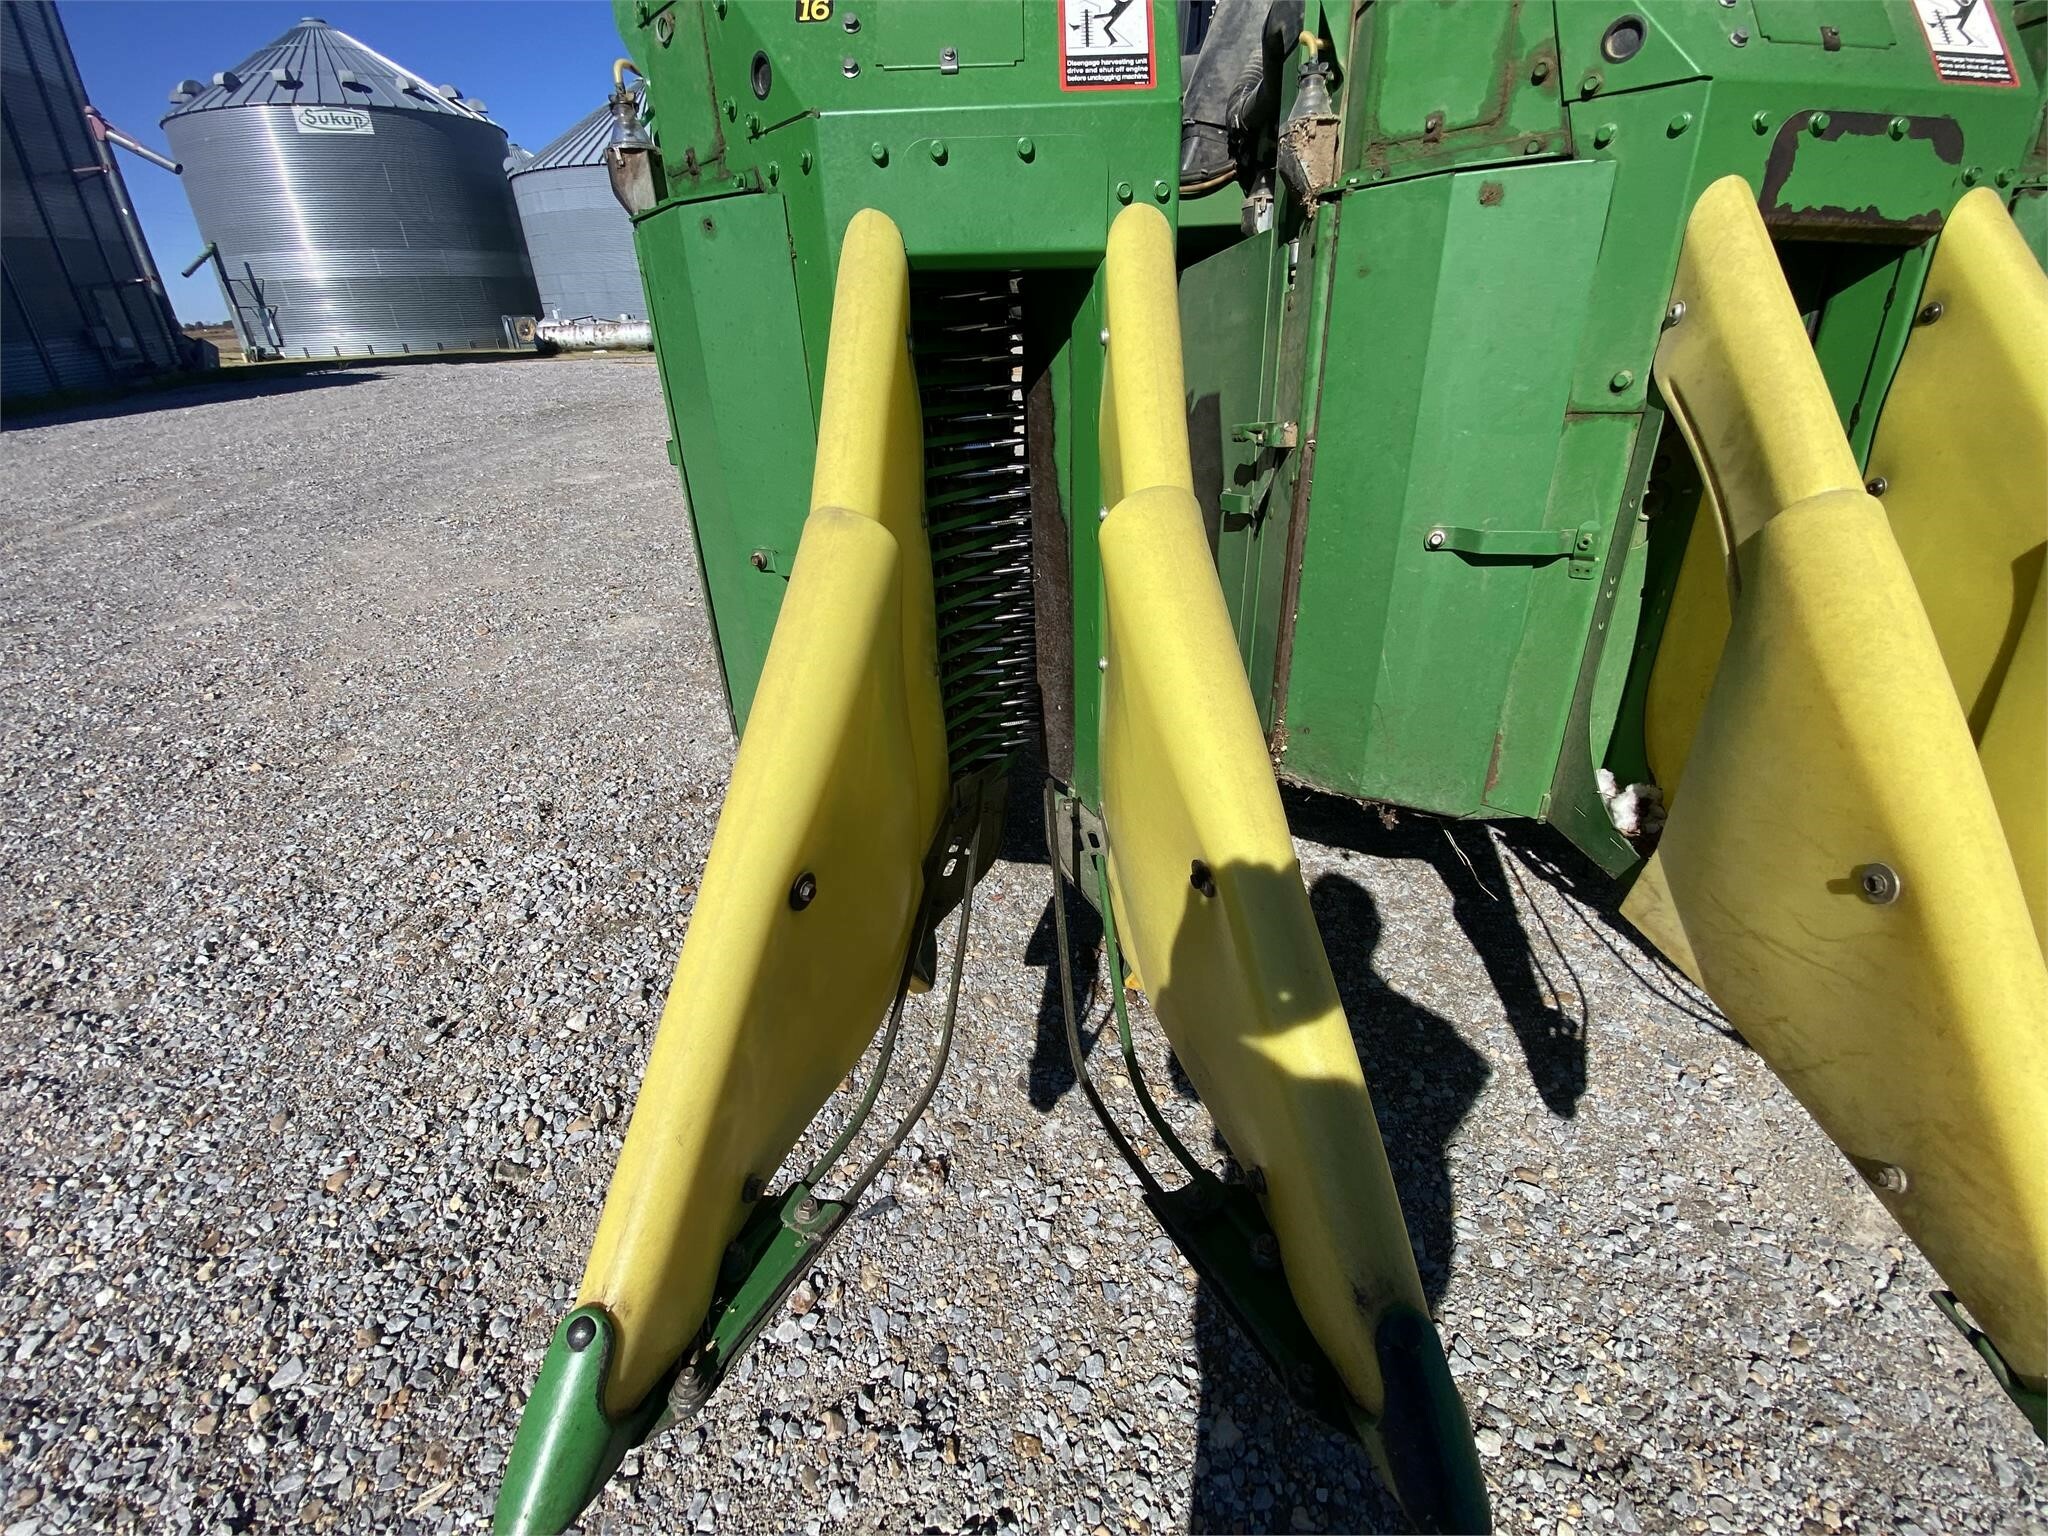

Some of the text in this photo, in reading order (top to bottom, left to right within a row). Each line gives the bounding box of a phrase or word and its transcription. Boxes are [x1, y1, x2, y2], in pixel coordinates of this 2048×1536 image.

[799, 0, 830, 21] 16
[1126, 65, 1149, 73] engine
[304, 108, 363, 129] Sukup
